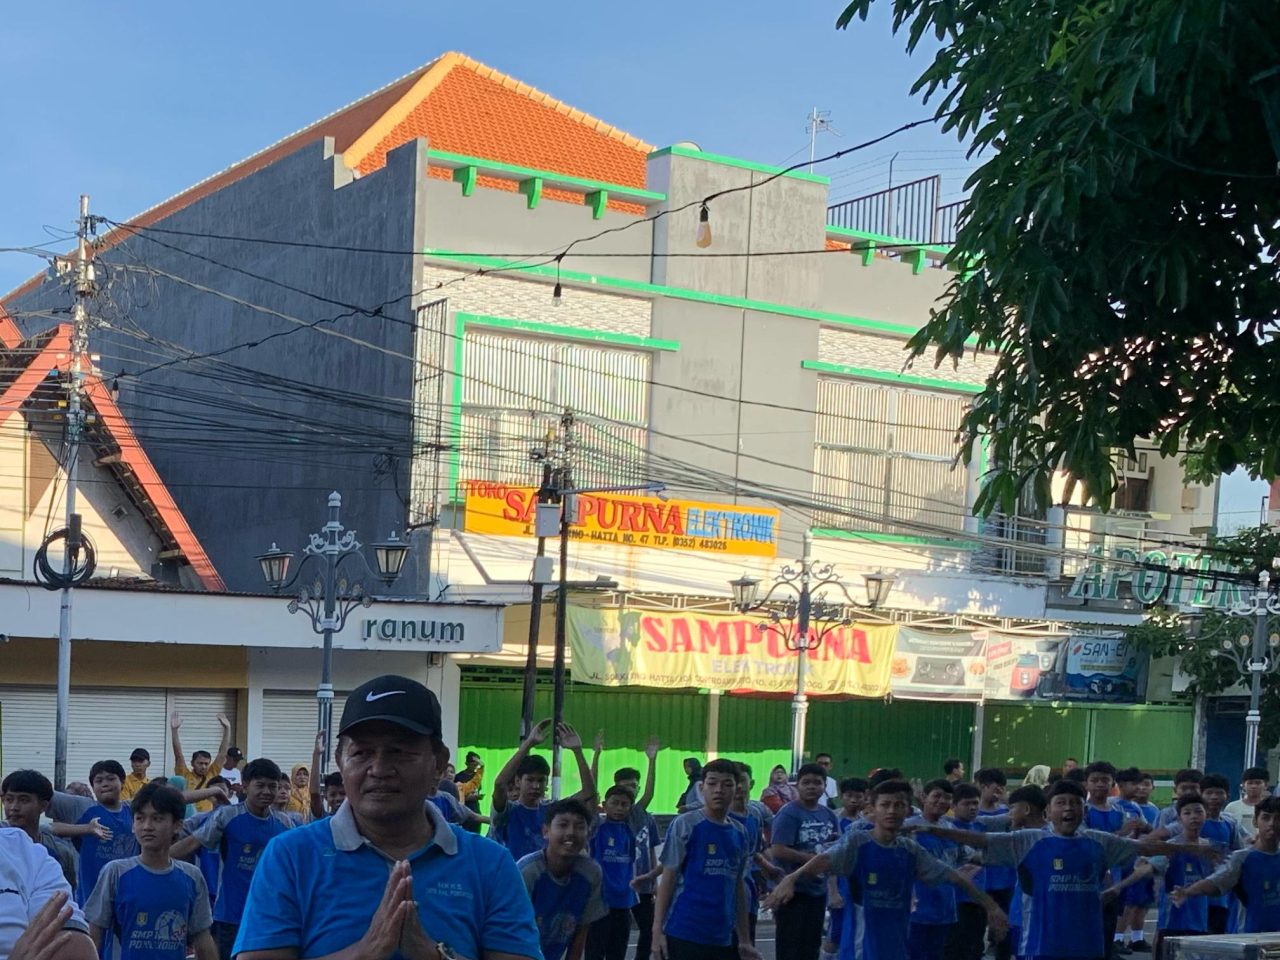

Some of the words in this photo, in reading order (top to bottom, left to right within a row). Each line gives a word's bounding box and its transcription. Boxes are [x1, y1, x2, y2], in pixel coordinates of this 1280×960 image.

[471, 480, 507, 498] TOKO
[503, 490, 685, 535] SAPURNA
[687, 508, 776, 544] ELEKTRONIK
[640, 535, 650, 544] 47
[365, 618, 466, 643] ranum
